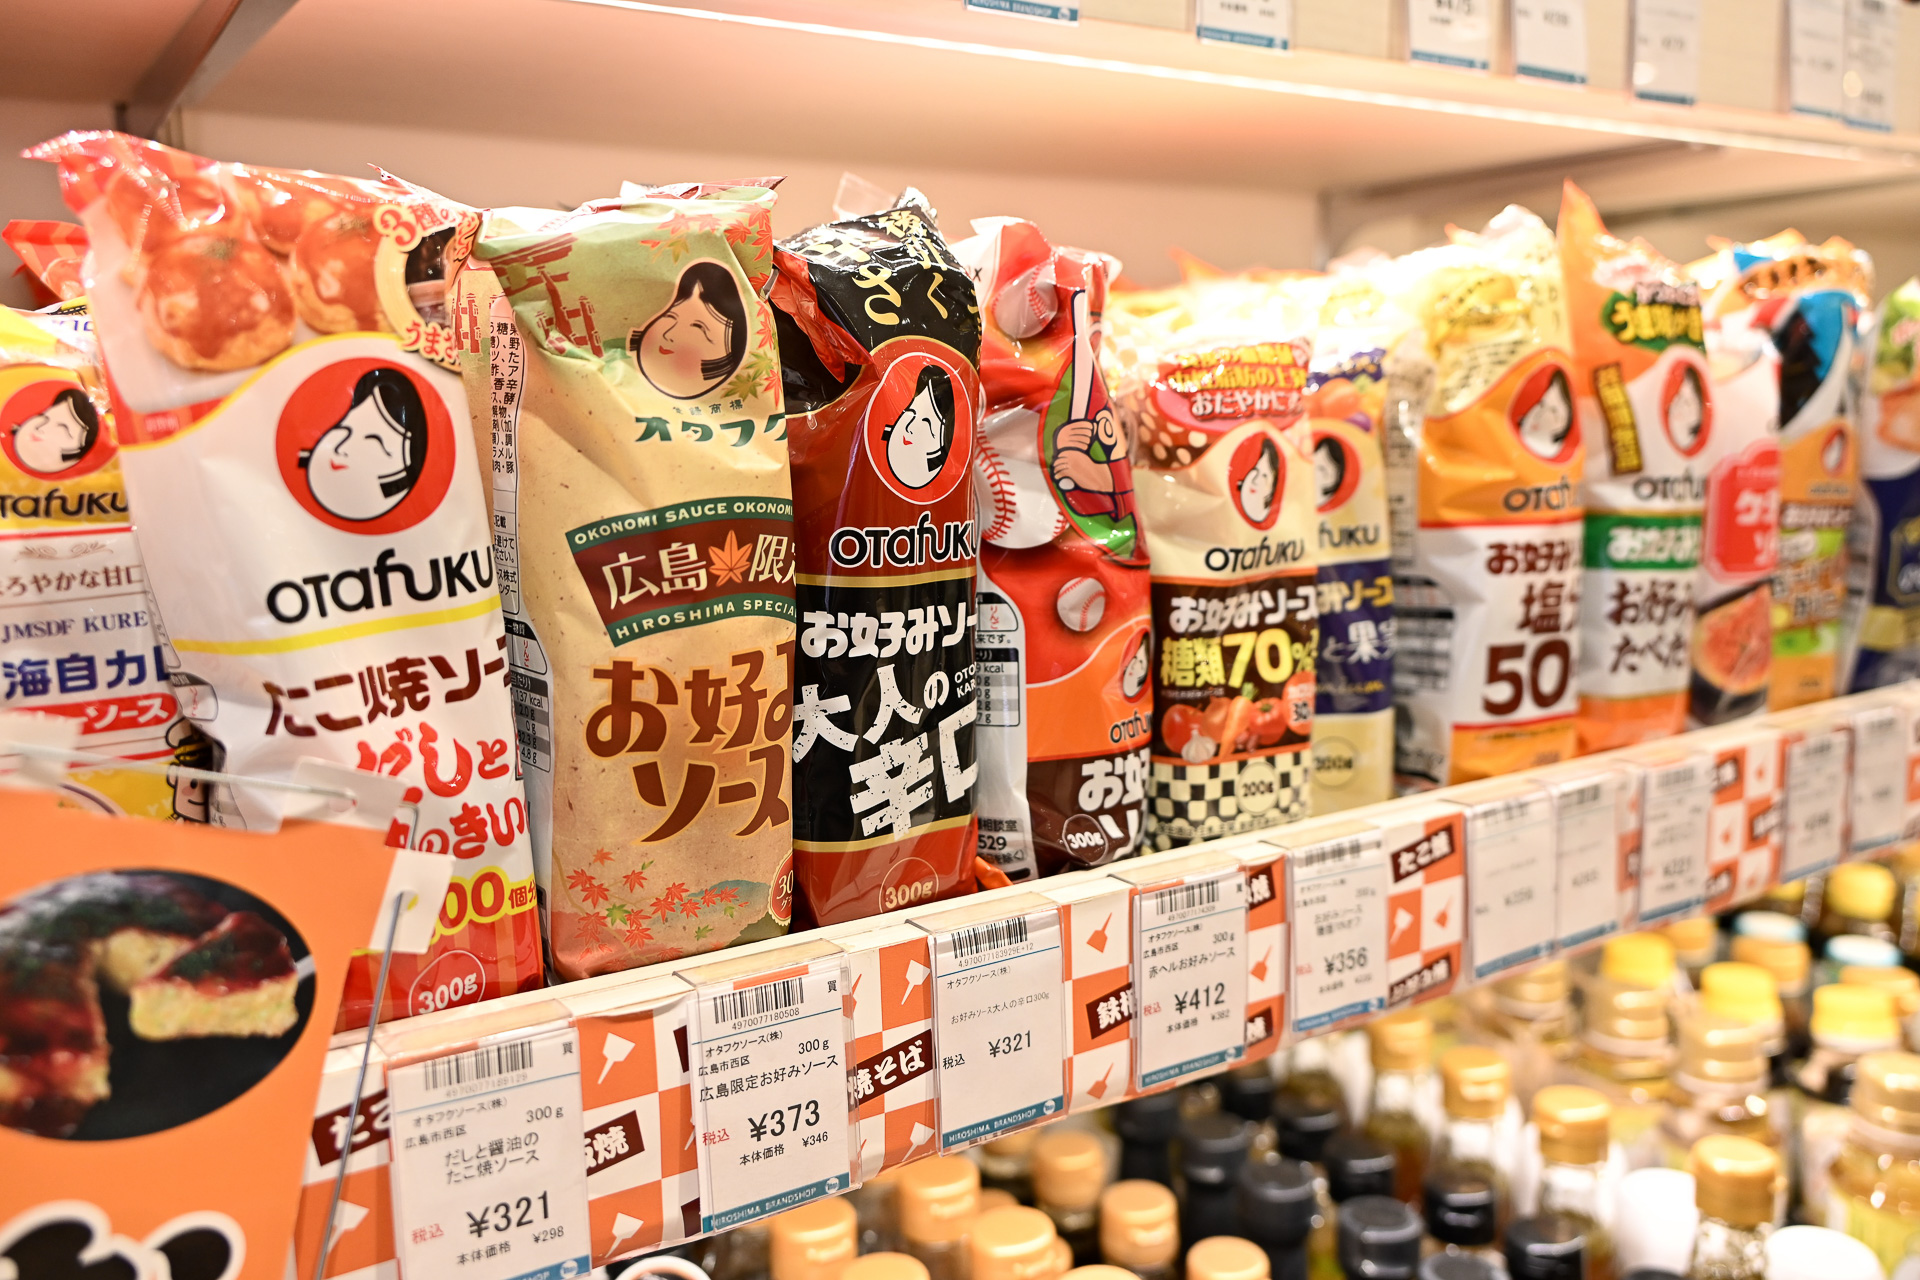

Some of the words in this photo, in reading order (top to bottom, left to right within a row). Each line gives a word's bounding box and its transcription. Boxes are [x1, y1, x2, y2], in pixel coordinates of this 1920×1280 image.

[573, 513, 659, 546] OKONOMI
[665, 502, 728, 524] SAUCE
[0, 564, 145, 596] ろやかな甘口
[602, 542, 708, 611] 広島
[2, 619, 75, 644] JMSDF
[84, 611, 149, 633] KURE
[615, 604, 736, 640] HIROSHIMA
[984, 662, 1004, 673] kcal
[1483, 638, 1571, 716] 50
[529, 695, 544, 708] kcal
[632, 744, 790, 843] ソース
[886, 881, 933, 909] 300g
[1324, 946, 1369, 975] ¥356
[946, 965, 1011, 990] オタフクソース(株)
[418, 972, 478, 1015] 300g
[1174, 982, 1226, 1014] ¥412
[731, 1007, 800, 1031] 4970077180508
[705, 1030, 783, 1059] オタフクソース(株)
[798, 1038, 820, 1055] 300
[822, 1039, 830, 1051] g
[988, 1030, 1032, 1058] ¥321
[698, 1055, 750, 1077] 広島市西区
[942, 1053, 966, 1070] 税込
[699, 1055, 839, 1103] 広島限定お好みソース
[526, 1105, 552, 1123] 300
[748, 1099, 821, 1143] ¥373
[949, 1124, 991, 1143] HIROSHIMA
[993, 1107, 1037, 1129] BRANDSHOP
[702, 1128, 731, 1147] 税込
[802, 1131, 829, 1148] ¥346
[739, 1142, 785, 1166] 本体価格
[466, 1190, 549, 1238] ¥321
[711, 1206, 762, 1228] HIROSHIMA
[765, 1186, 817, 1211] BRANDSHOP
[412, 1223, 445, 1245] 税込
[532, 1225, 565, 1245] ¥298
